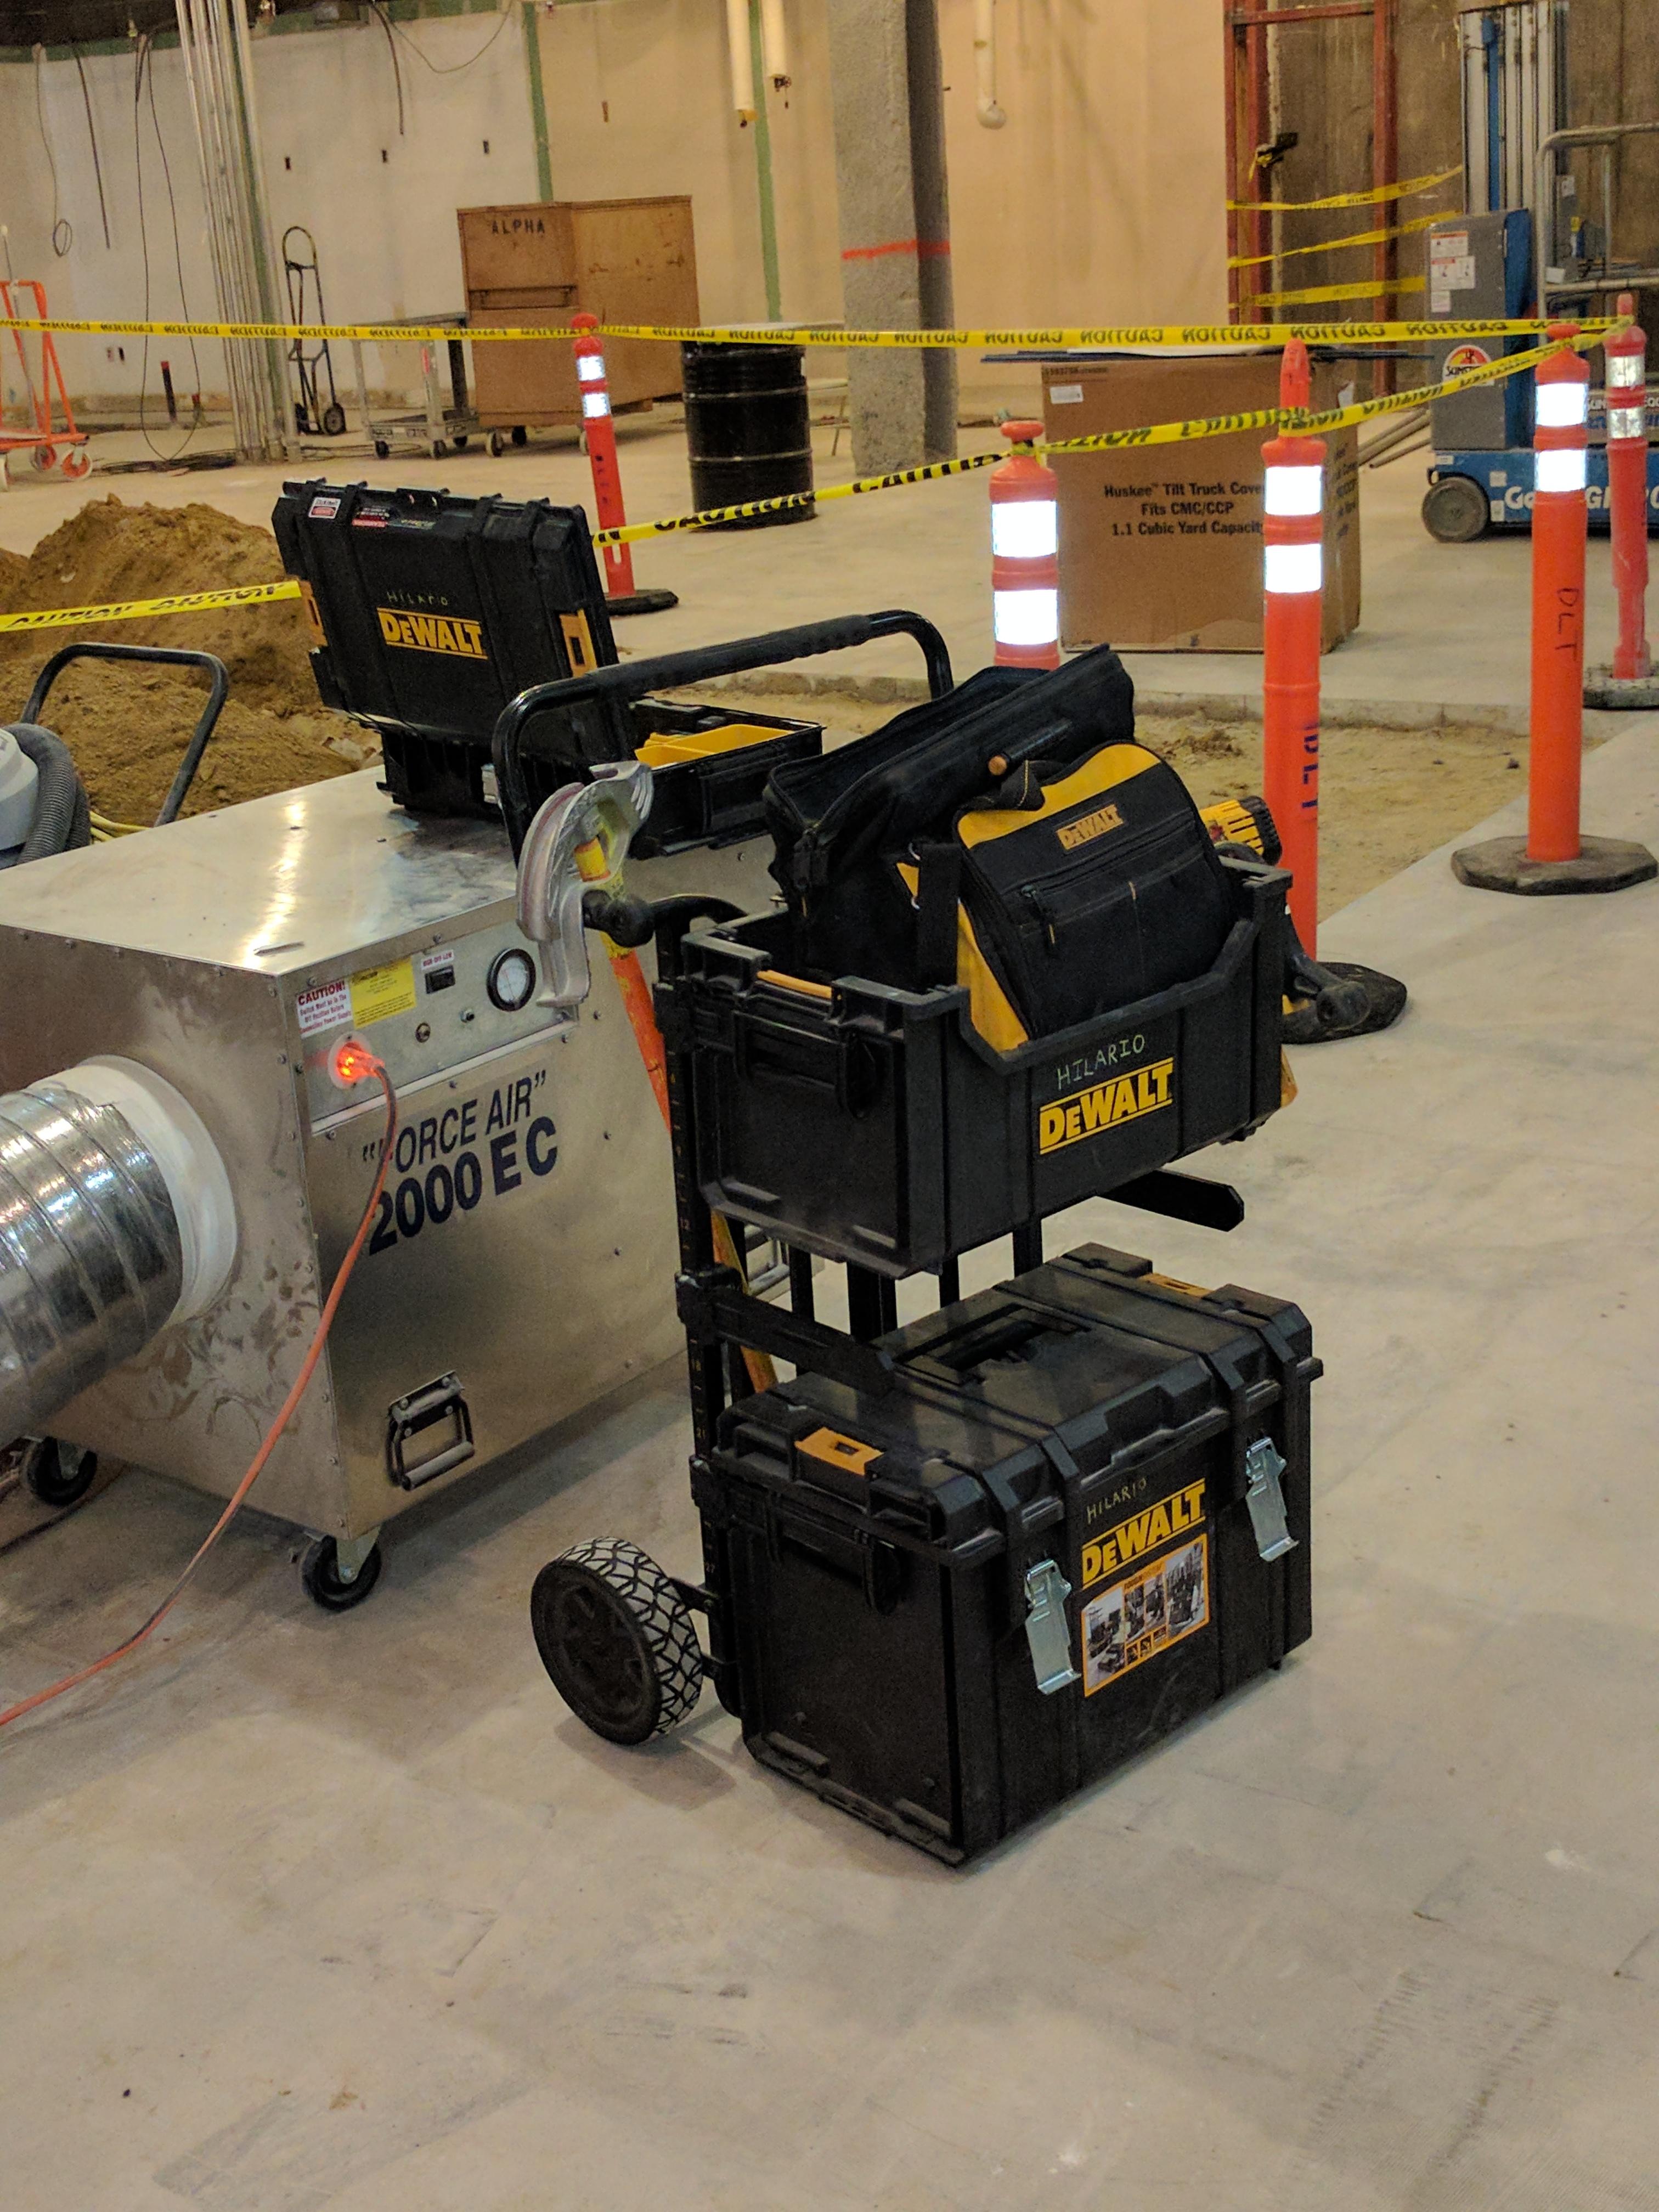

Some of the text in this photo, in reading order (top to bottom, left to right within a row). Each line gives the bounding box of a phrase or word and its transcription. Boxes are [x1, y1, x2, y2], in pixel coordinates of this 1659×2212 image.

[492, 219, 545, 234] ALPHA
[1141, 501, 1234, 516] Fits CMC/CCP
[1163, 483, 1185, 496] Tilt
[1188, 482, 1225, 495] Truck
[1112, 523, 1132, 536] 1.1
[1138, 522, 1175, 535] Cubic
[1178, 522, 1206, 535] Yard
[378, 610, 484, 657] DEWALT
[298, 980, 345, 1006] CAUTION!
[1057, 1034, 1145, 1091] HILARIO
[1040, 1059, 1174, 1152] DEWALT
[369, 1151, 483, 1256] 2000
[1086, 1477, 1147, 1525] HILARIO
[1082, 1482, 1206, 1587] DEWALT
